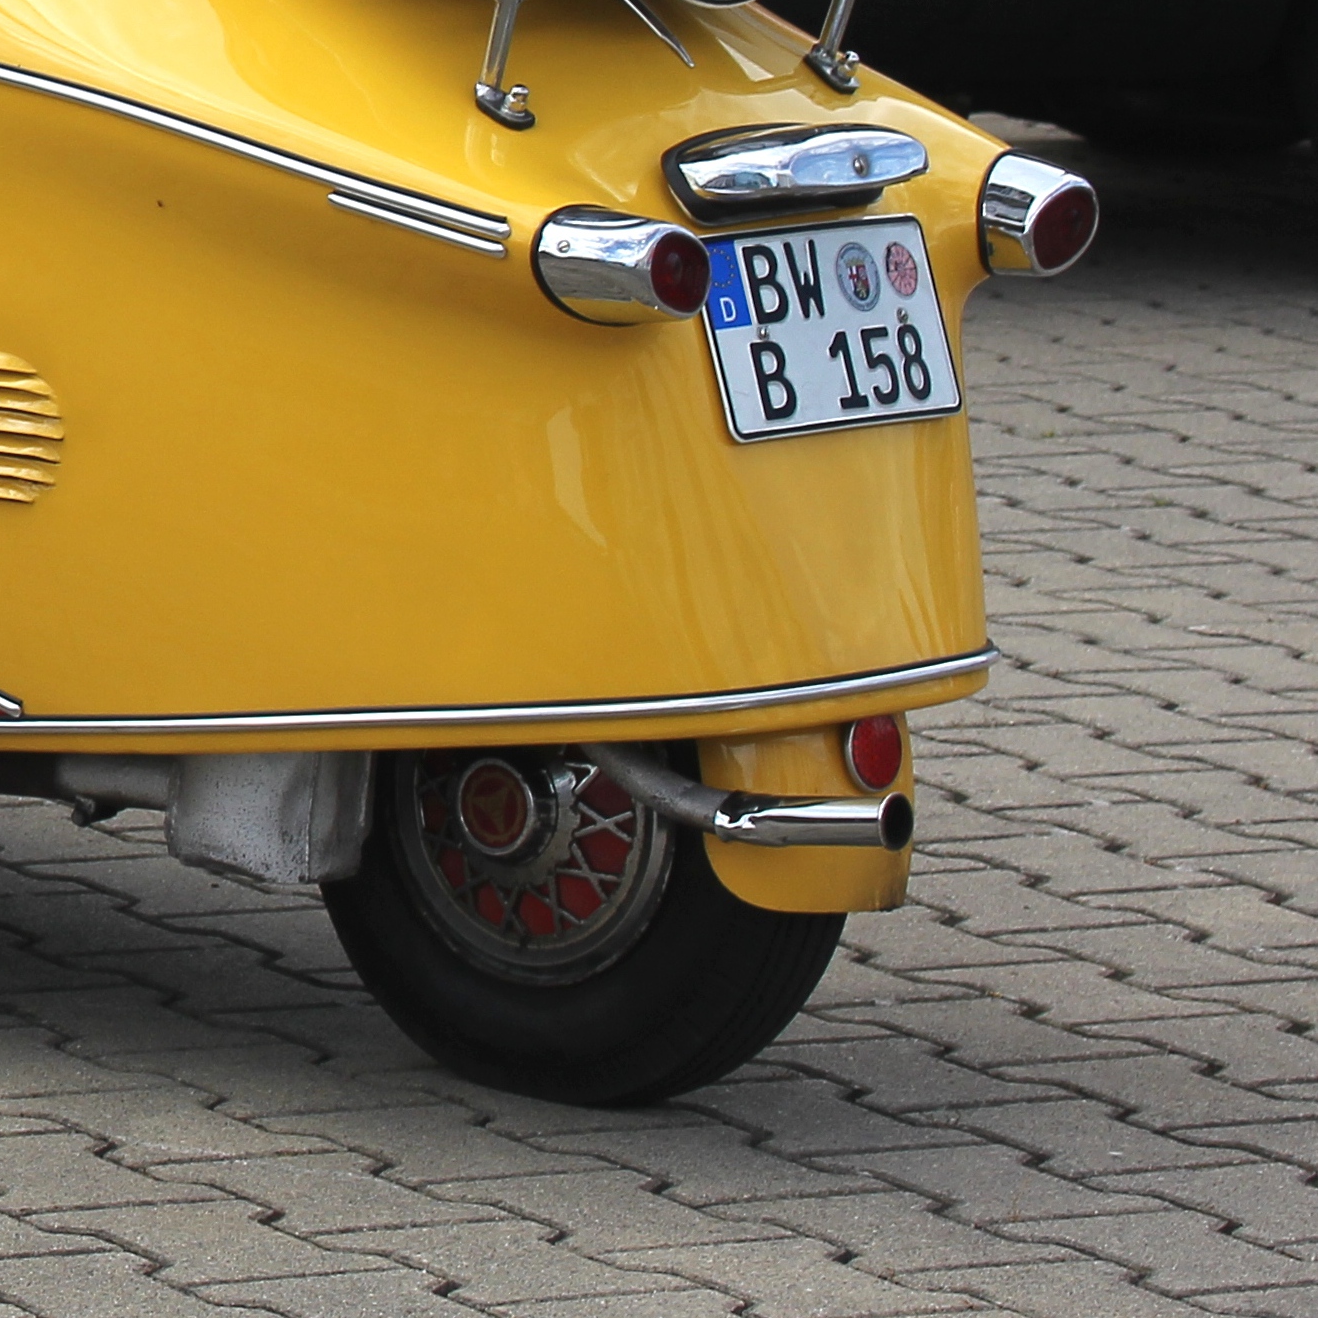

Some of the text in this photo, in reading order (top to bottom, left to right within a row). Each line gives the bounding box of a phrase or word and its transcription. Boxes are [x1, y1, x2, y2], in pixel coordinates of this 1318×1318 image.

[720, 296, 737, 323] D
[742, 237, 826, 324] BW
[751, 324, 931, 421] B 158
